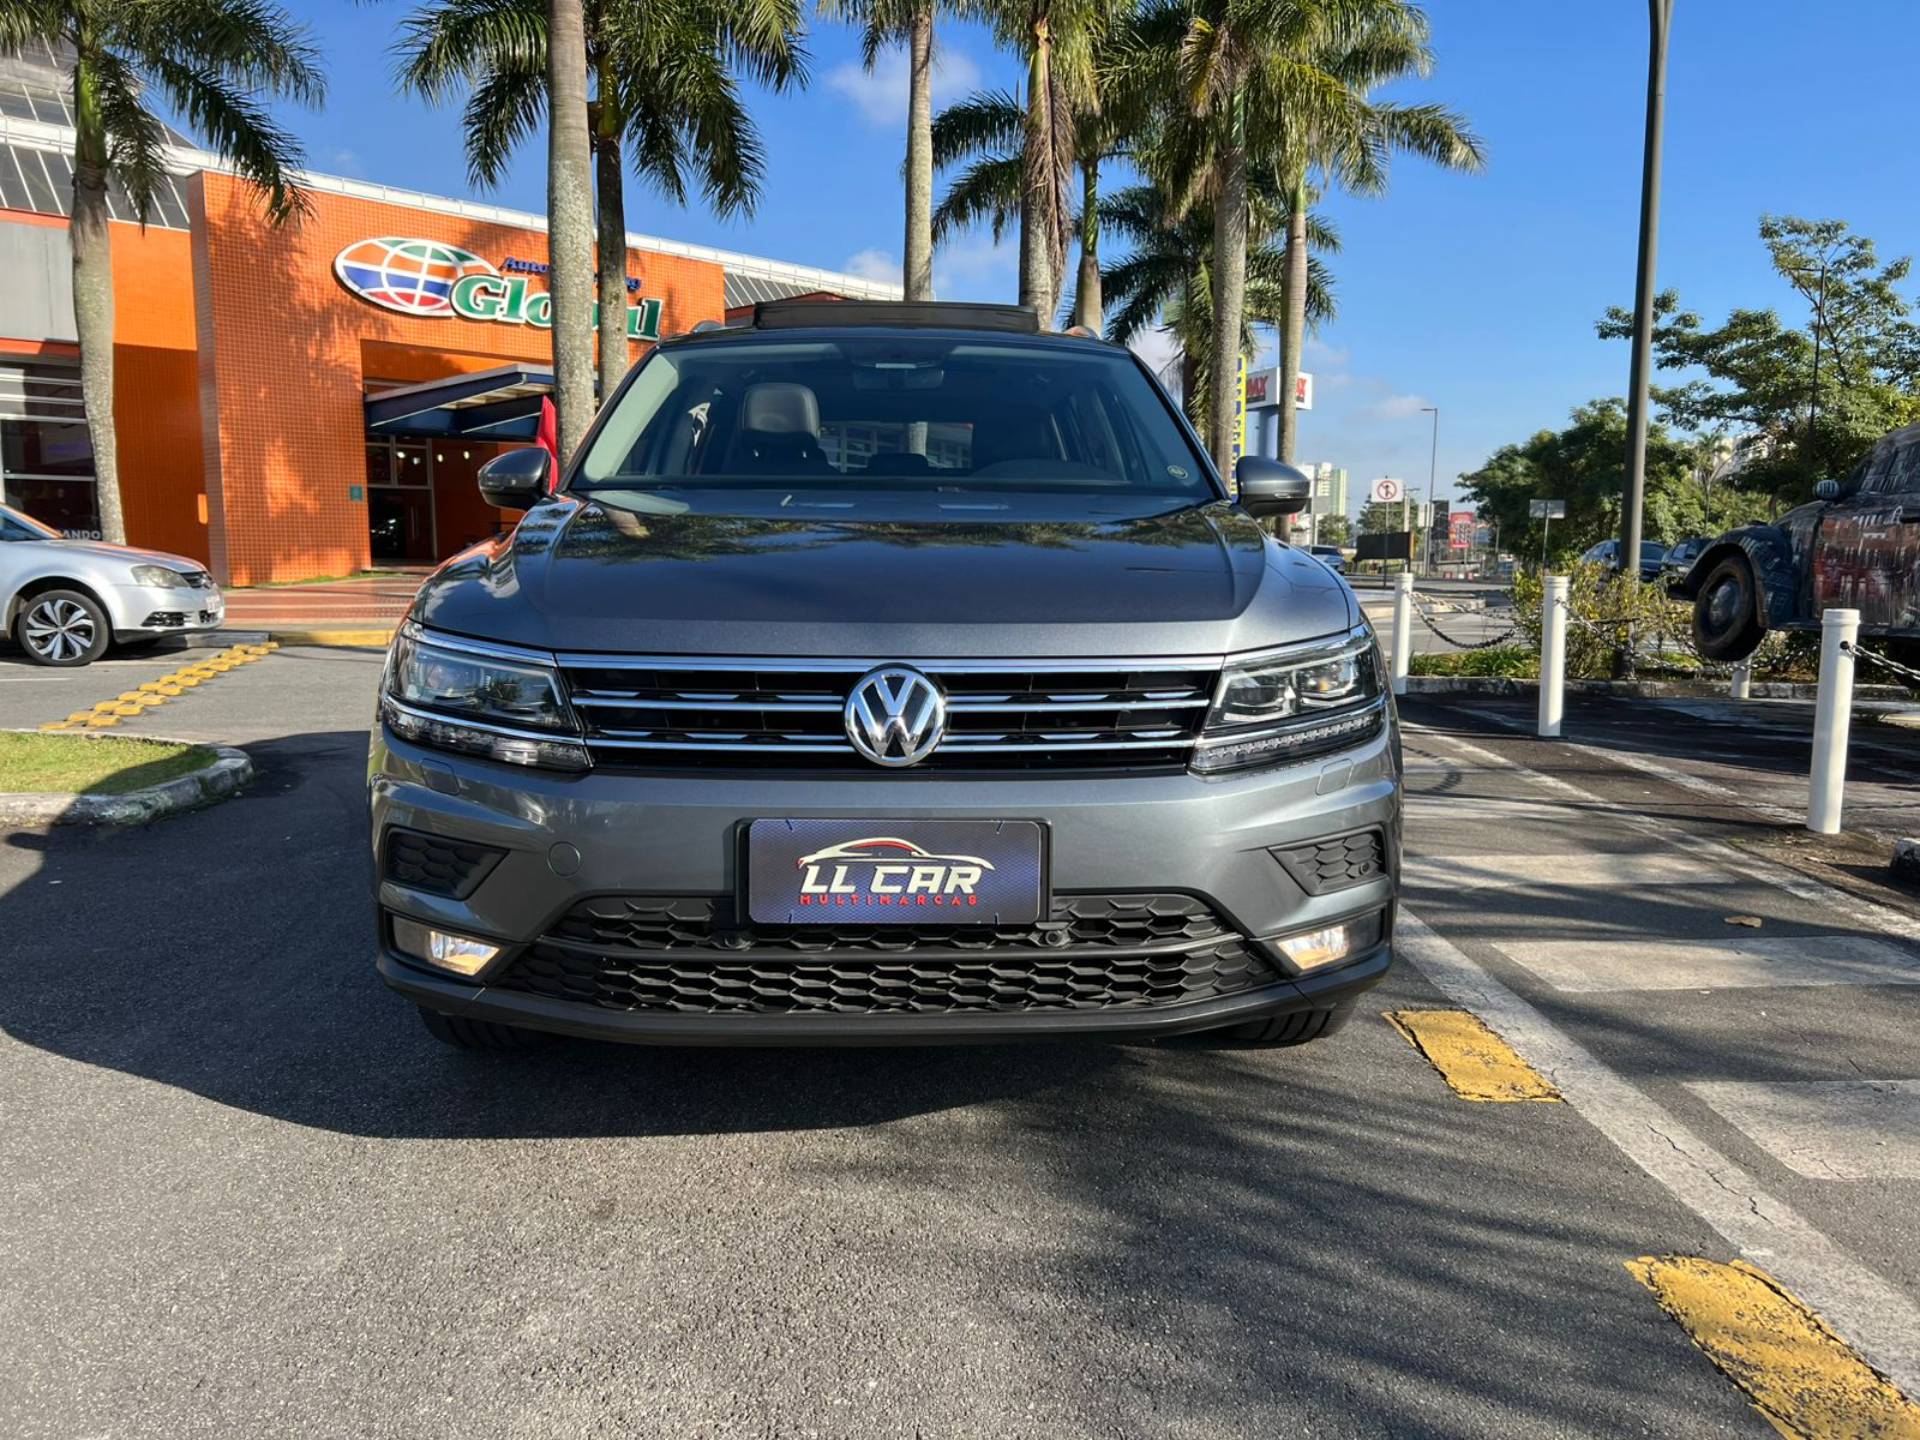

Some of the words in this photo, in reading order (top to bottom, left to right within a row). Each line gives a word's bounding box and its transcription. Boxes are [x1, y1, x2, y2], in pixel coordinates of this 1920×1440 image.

[452, 275, 663, 341] Glol
[801, 865, 856, 894] LL
[870, 866, 982, 894] CAR
[800, 894, 978, 906] MULTIMARCAS
